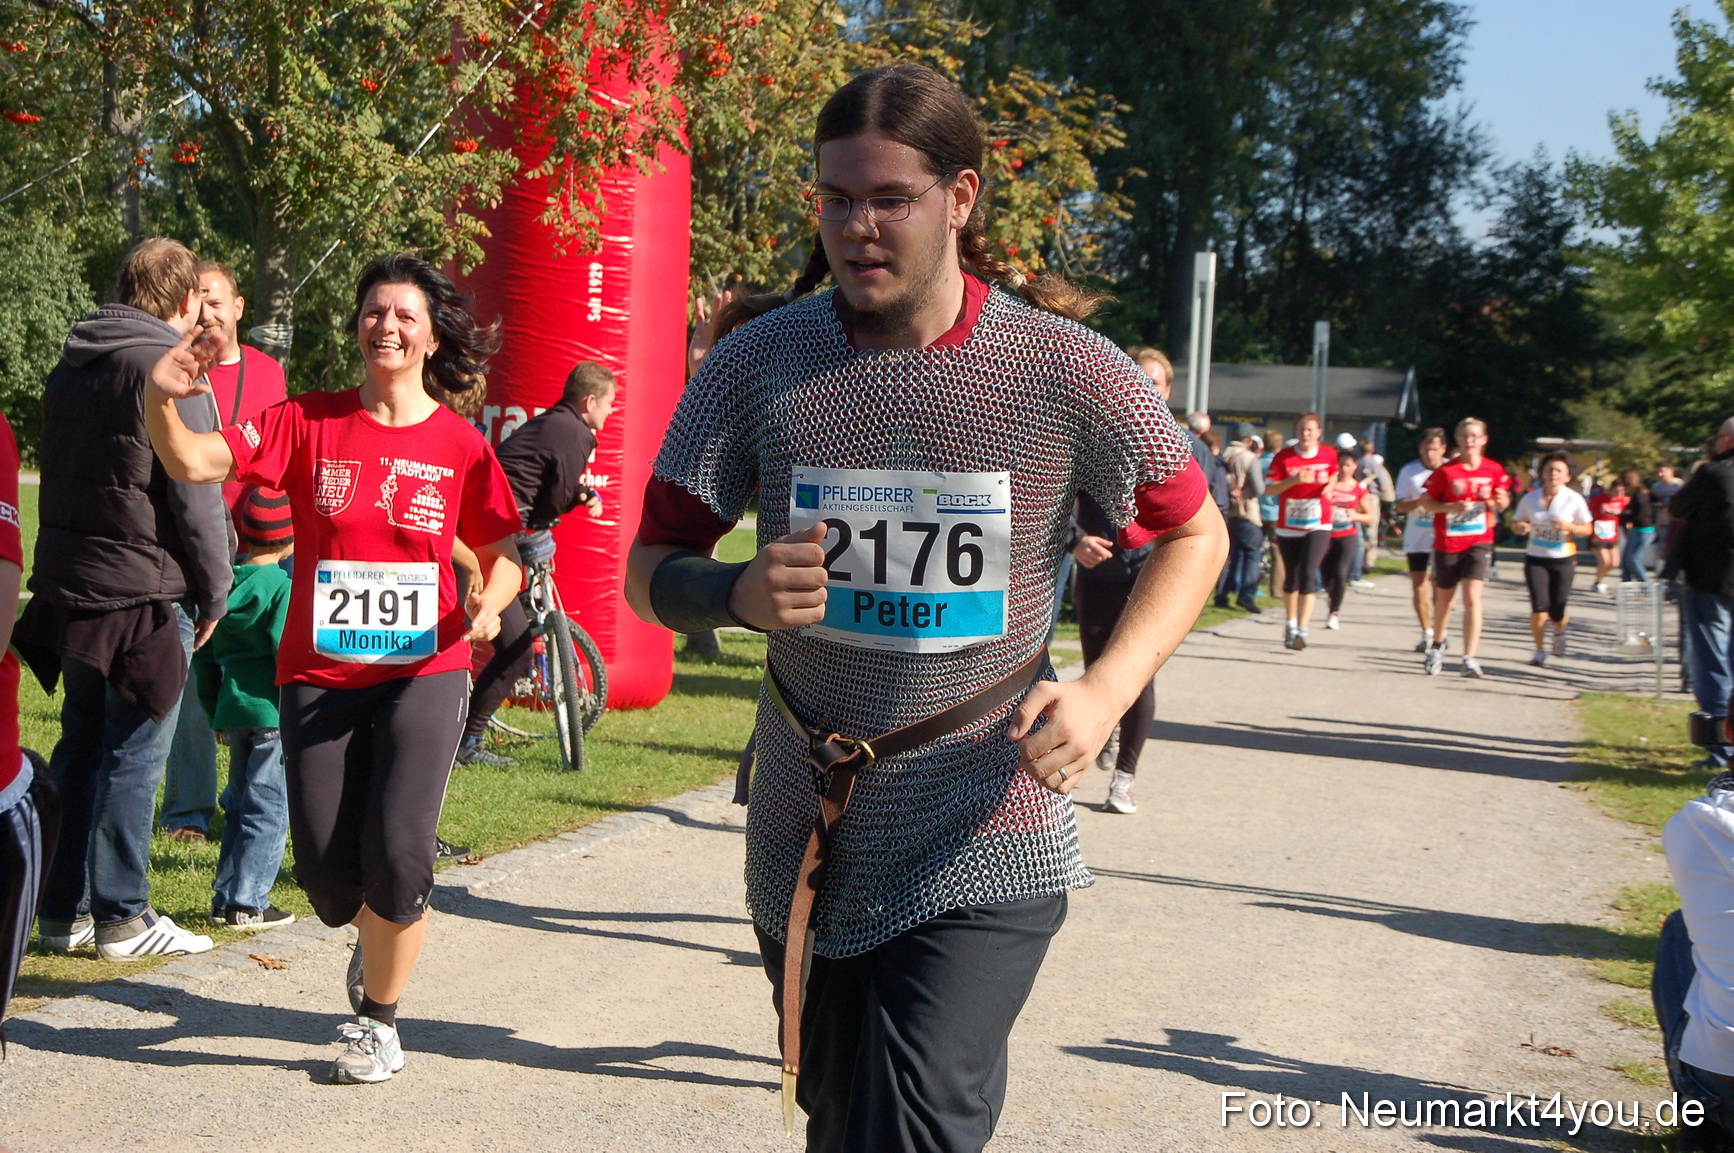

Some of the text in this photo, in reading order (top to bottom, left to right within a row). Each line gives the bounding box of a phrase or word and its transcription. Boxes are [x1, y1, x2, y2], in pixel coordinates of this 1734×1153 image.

[587, 262, 604, 321] Seit 1929
[319, 467, 351, 477] IMMER
[379, 457, 454, 478] 11. NEUMARKTER
[390, 466, 441, 483] STADTLAUF
[316, 485, 347, 498] NEU
[822, 485, 914, 503] PFLEIDERER
[315, 497, 344, 507] MARKT
[822, 504, 914, 513] AKTIENGESELLSCHAFT
[936, 494, 992, 507] BOCK
[821, 517, 984, 587] 2176
[333, 571, 385, 580] PFLEIDERER
[328, 588, 419, 626] 2191
[853, 591, 948, 628] Peter
[339, 630, 413, 650] Monika
